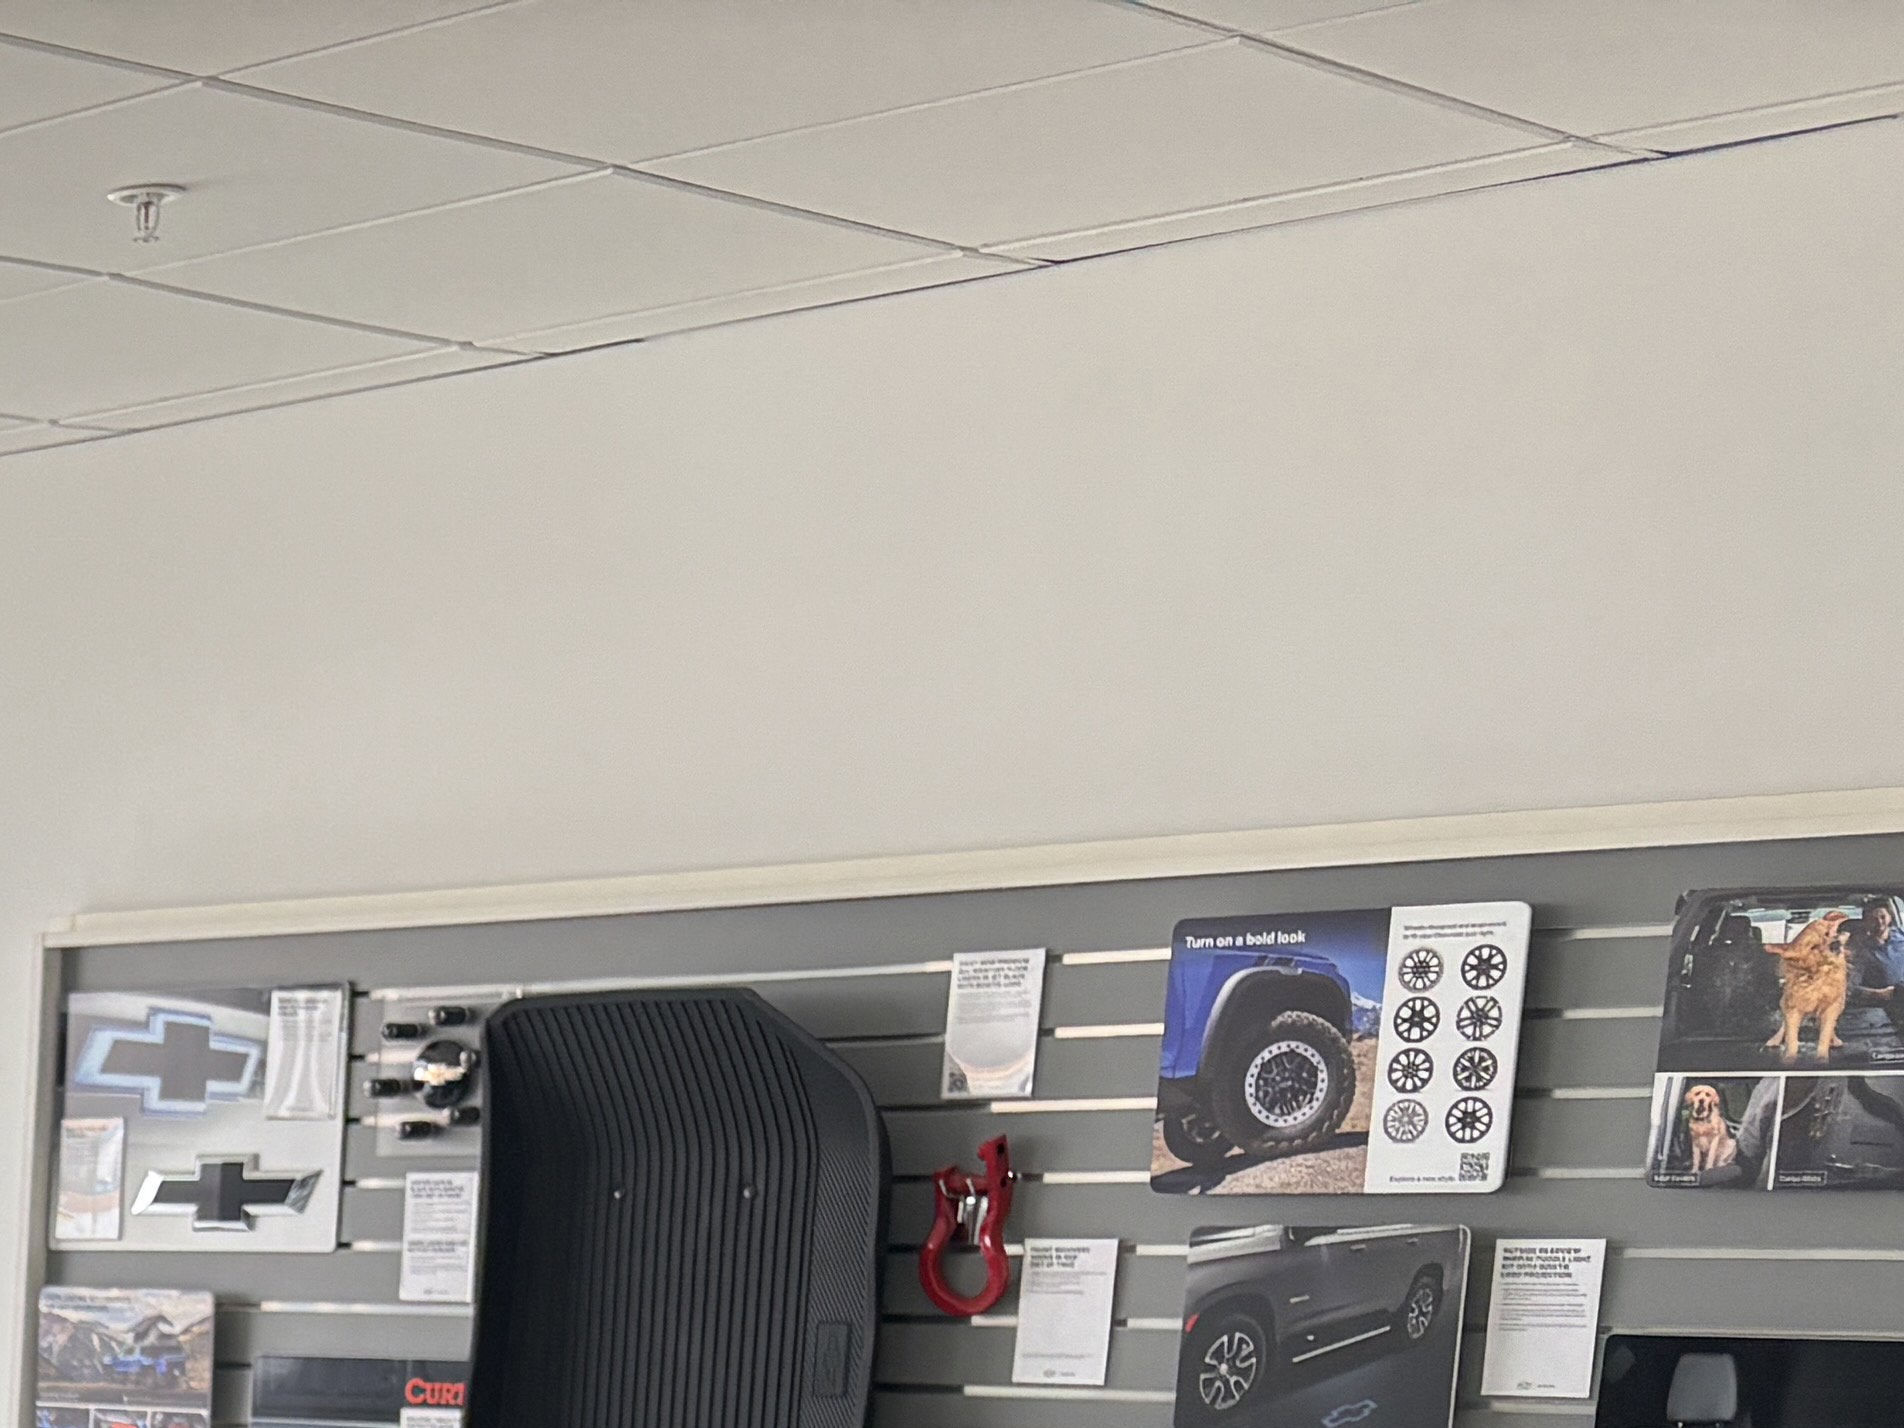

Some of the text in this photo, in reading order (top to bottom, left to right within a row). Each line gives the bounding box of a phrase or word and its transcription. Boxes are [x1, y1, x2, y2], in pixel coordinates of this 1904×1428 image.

[1185, 930, 1306, 949] Turn on a bold look
